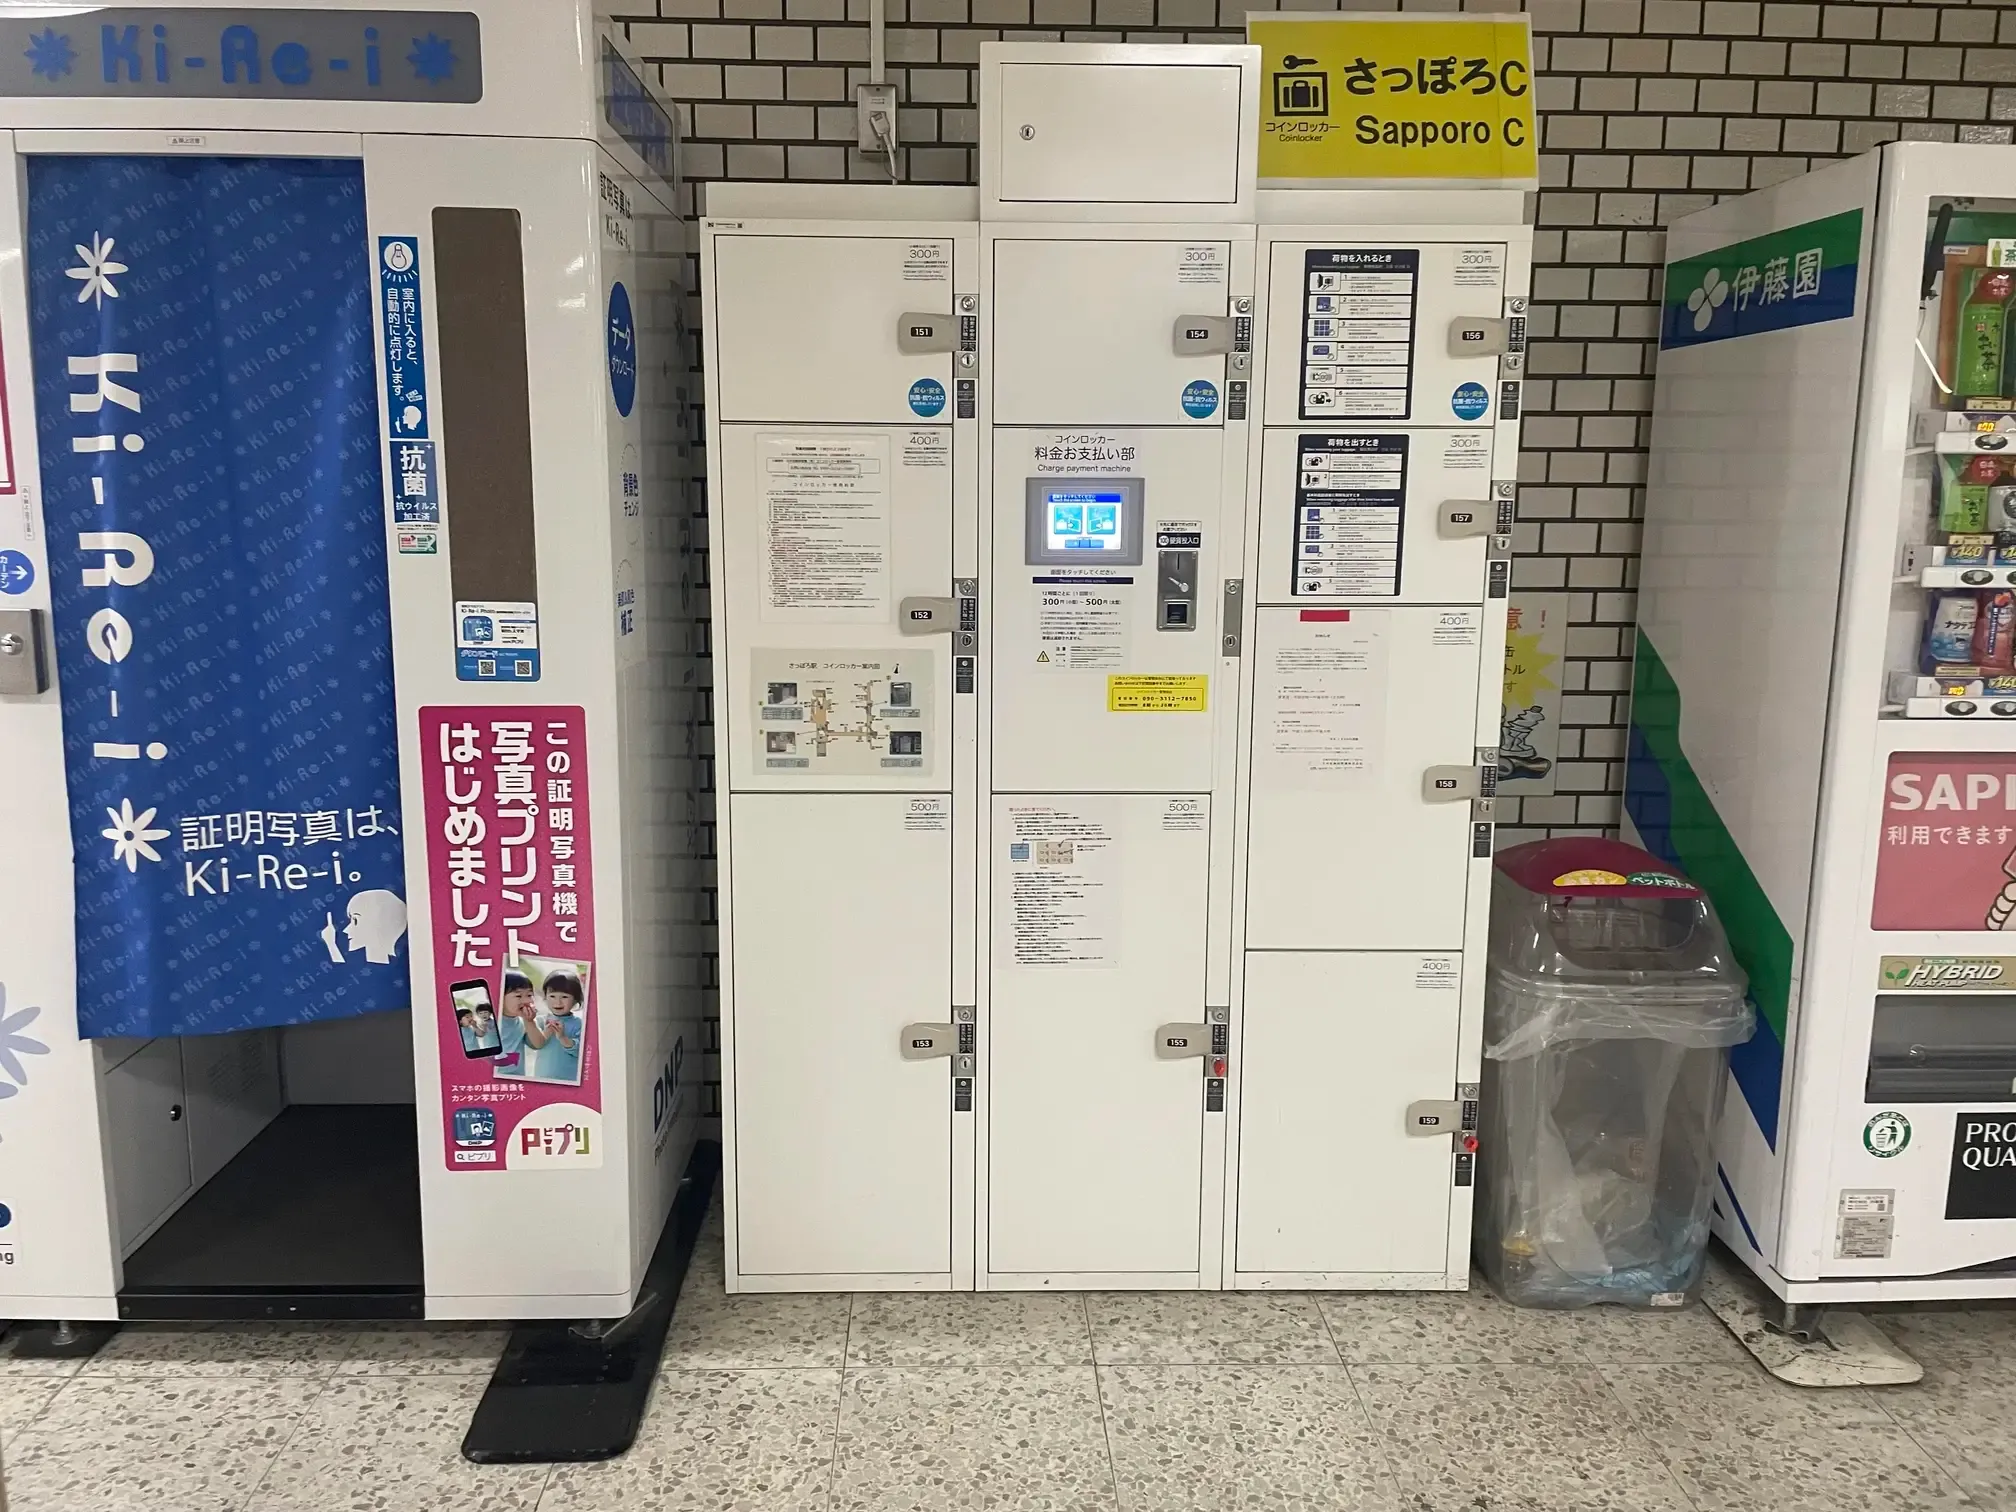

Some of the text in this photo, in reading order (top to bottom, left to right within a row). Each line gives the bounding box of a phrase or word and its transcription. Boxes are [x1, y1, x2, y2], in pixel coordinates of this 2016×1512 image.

[101, 24, 381, 87] Ki-Re-i
[1265, 122, 1340, 133] コインロッカー
[1355, 114, 1525, 148] Sapporo C
[1279, 134, 1322, 142] Coinlocker
[910, 249, 940, 259] 300円
[1185, 252, 1215, 261] 300円
[1332, 254, 1392, 263] 荷物を入れるとき
[1462, 254, 1492, 264] 300円
[1732, 248, 1823, 312] 伊藤園
[402, 287, 418, 365] 室内に入ると、
[387, 288, 405, 401] 自動的に点灯します。
[910, 436, 940, 445] 400円
[1055, 436, 1115, 444] コインロッカー
[1450, 439, 1480, 447] 300円
[1034, 447, 1135, 461] 料金お支払い部
[400, 445, 427, 497] 抗菌
[1038, 464, 1064, 472] Charge
[395, 501, 438, 511] 抗ウイルス
[403, 512, 430, 522] 加工済
[910, 802, 940, 811] 500円
[1168, 803, 1197, 811] 500円
[180, 806, 400, 852] 証明写真は、
[545, 722, 578, 943] この証明写真機で
[1888, 825, 2012, 845] 利用できます
[440, 722, 493, 968] はじめました
[490, 722, 542, 968] 写真プリント
[1632, 877, 1698, 891] ペットボトル
[1904, 965, 2004, 987] HYBRID
[452, 1084, 525, 1092] スマホの撮影画像を
[654, 1035, 683, 1134] DNP
